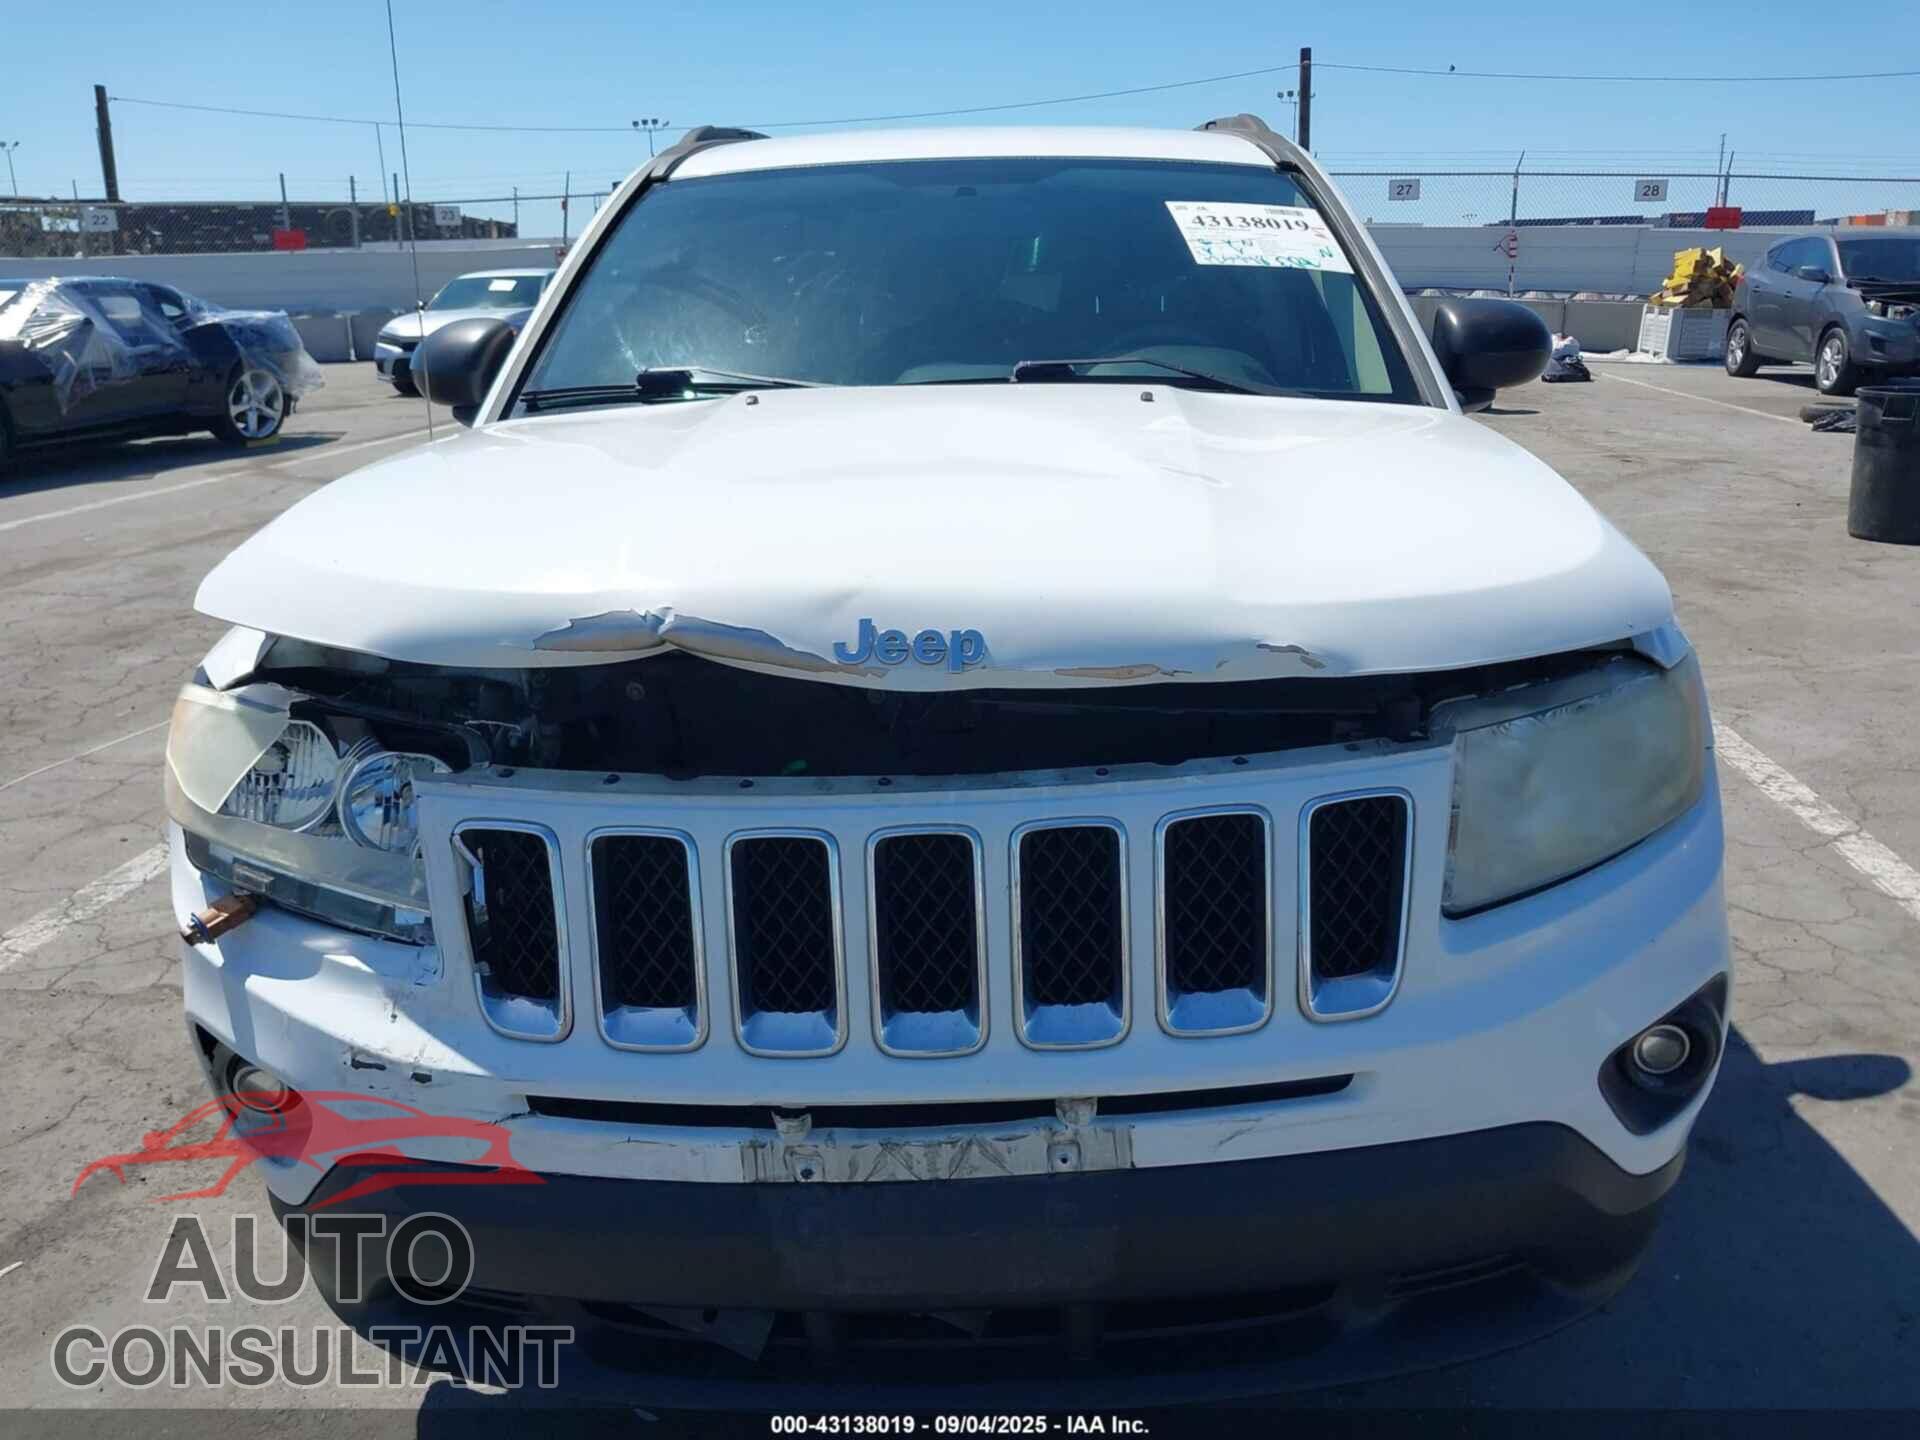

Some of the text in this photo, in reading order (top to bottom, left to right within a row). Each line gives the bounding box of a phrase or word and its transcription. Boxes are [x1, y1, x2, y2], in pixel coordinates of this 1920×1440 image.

[1396, 184, 1412, 196] 27
[1642, 184, 1660, 197] 28
[1191, 214, 1310, 232] 43138019
[833, 618, 985, 672] Jeep
